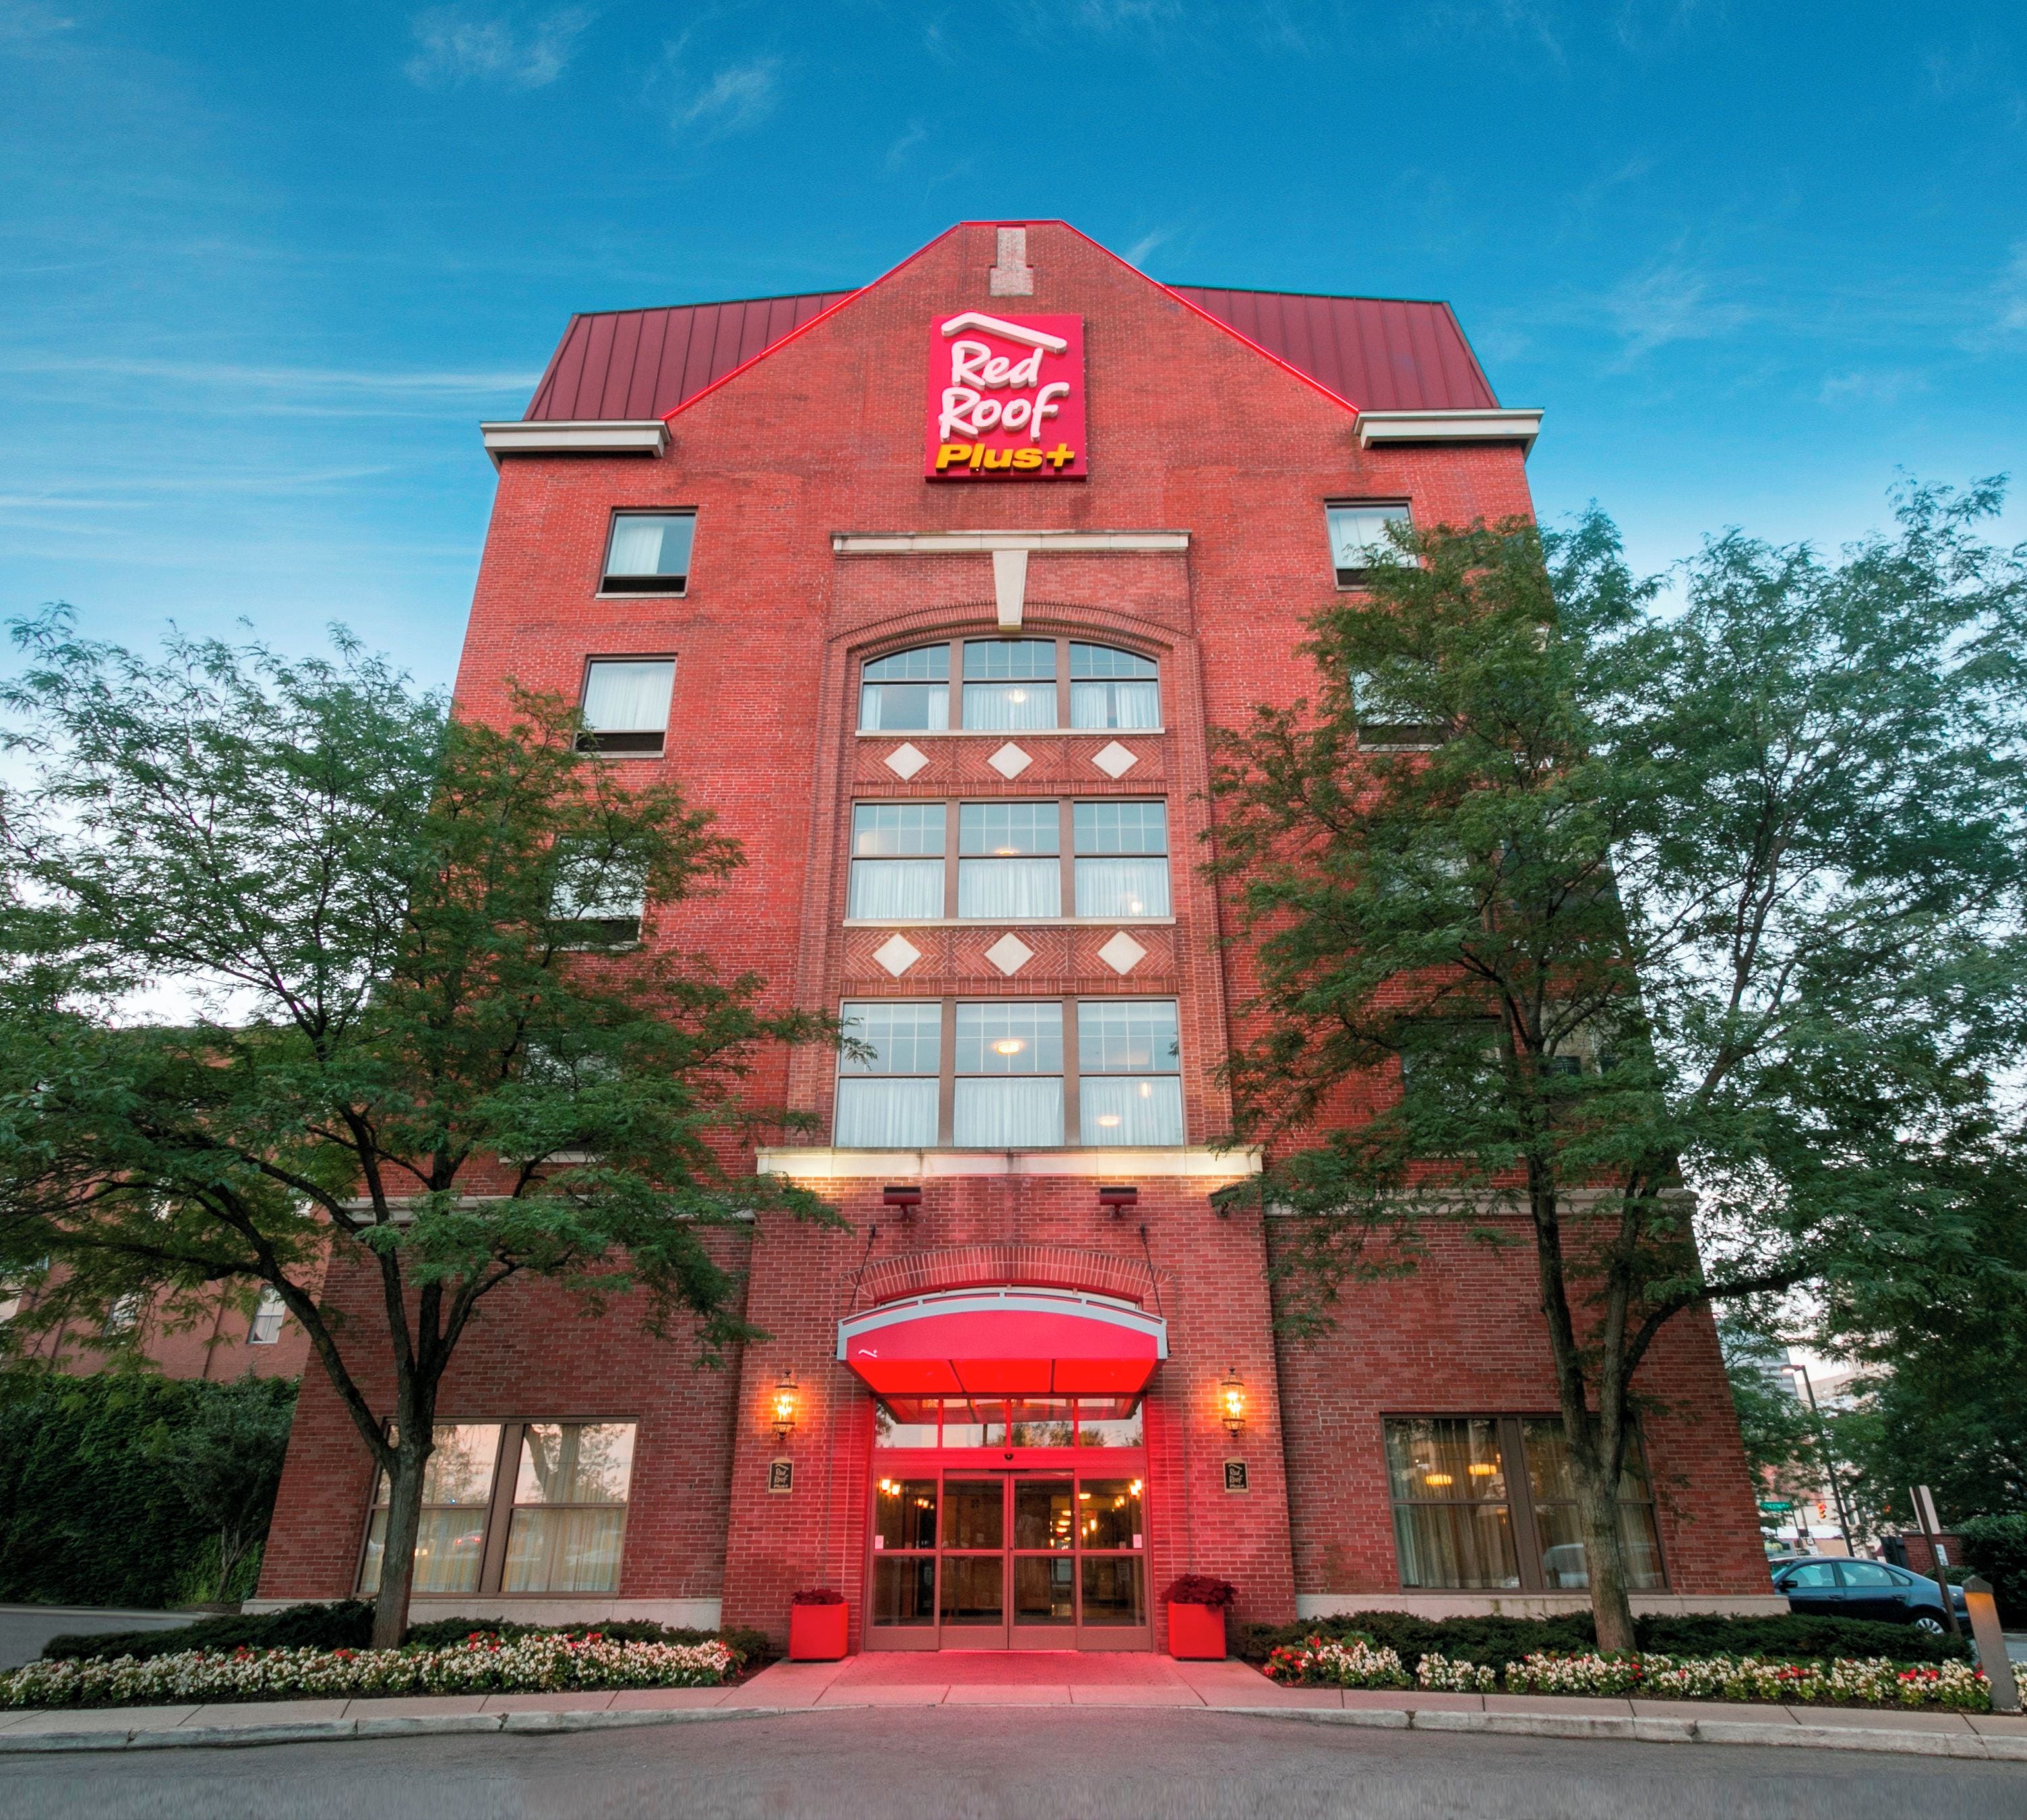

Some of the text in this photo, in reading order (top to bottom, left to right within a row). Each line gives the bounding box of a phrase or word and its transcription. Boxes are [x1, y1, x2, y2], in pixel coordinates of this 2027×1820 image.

[951, 340, 1043, 391] Red
[938, 382, 1070, 442] Roof
[935, 443, 1075, 471] Plus+
